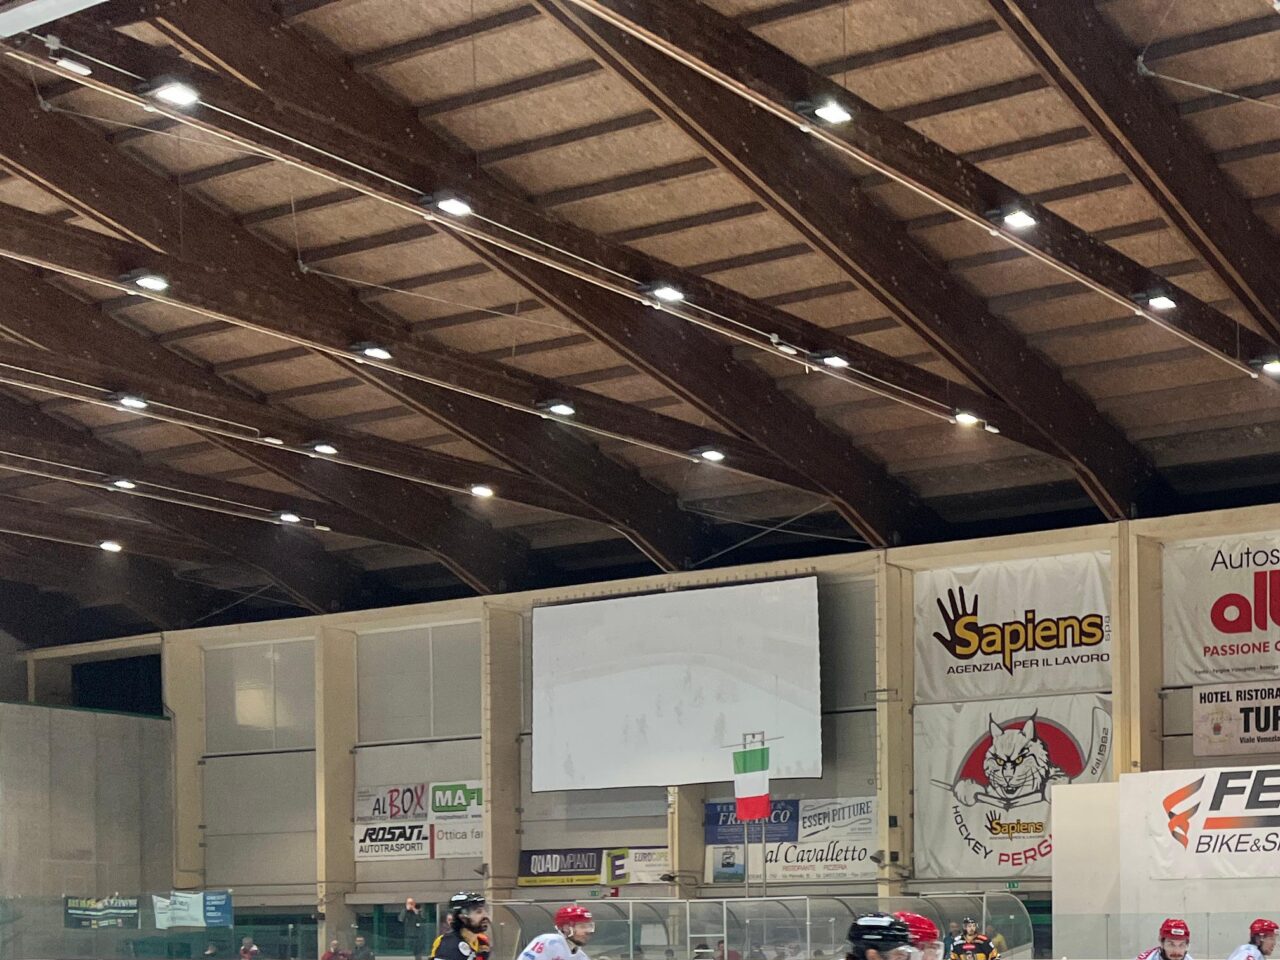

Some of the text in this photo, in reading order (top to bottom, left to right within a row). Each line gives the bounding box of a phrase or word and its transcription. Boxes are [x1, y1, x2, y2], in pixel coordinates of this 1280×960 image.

[953, 610, 1105, 676] Sapiens
[1203, 641, 1270, 658] PASSIONE
[946, 653, 1110, 675] AGENZIA PER IL LAVORO
[1200, 690, 1233, 704] HOTEL
[1099, 727, 1109, 757] 1982
[1239, 736, 1256, 744] Viale
[1256, 735, 1280, 744] Venezia
[831, 800, 872, 822] PITTURE
[436, 829, 468, 841] Ottica
[952, 805, 993, 860] HOCKEY
[991, 819, 1045, 842] Sapiens
[359, 842, 423, 854] AUTOTRASPORTI
[765, 841, 867, 864] al Cavalletto
[998, 833, 1052, 866] PERG
